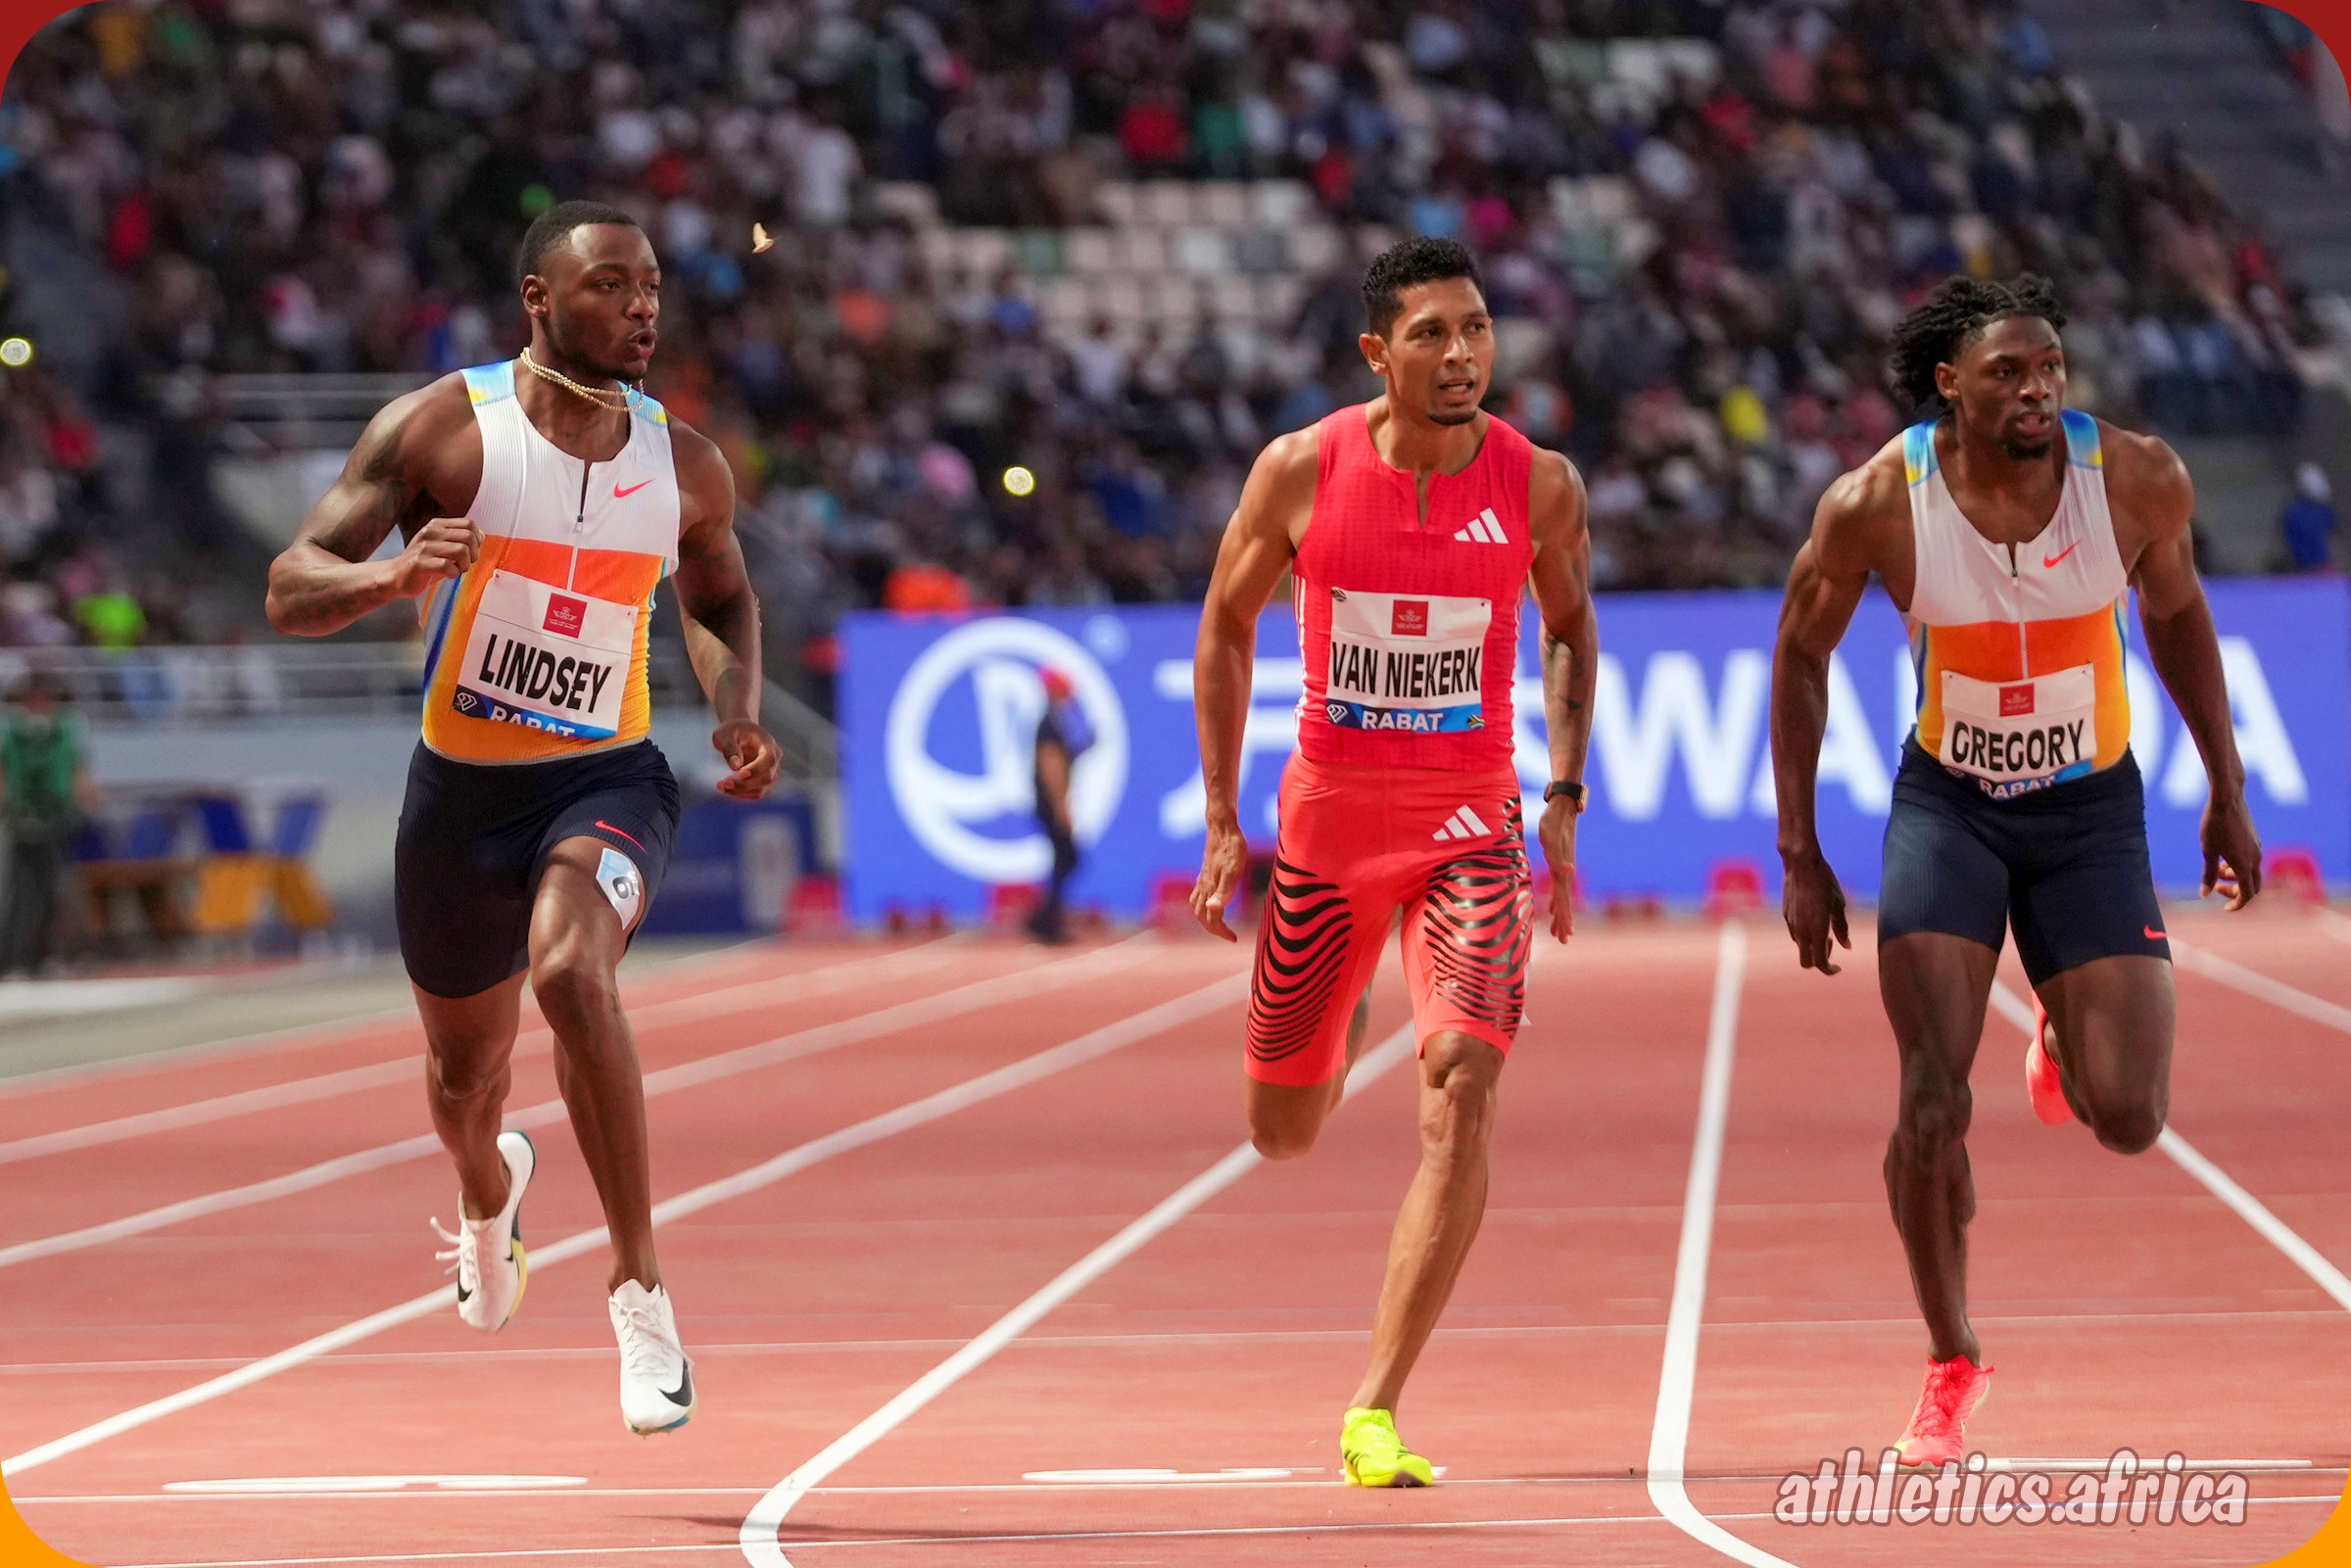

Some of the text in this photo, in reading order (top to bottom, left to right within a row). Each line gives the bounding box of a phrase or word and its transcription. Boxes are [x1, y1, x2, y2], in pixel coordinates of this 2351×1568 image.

[478, 634, 613, 713] LINDSEY
[1331, 642, 1481, 698] VAN NIEKERK
[1361, 710, 1445, 733] RABAT
[1950, 718, 2086, 773] GREGORY
